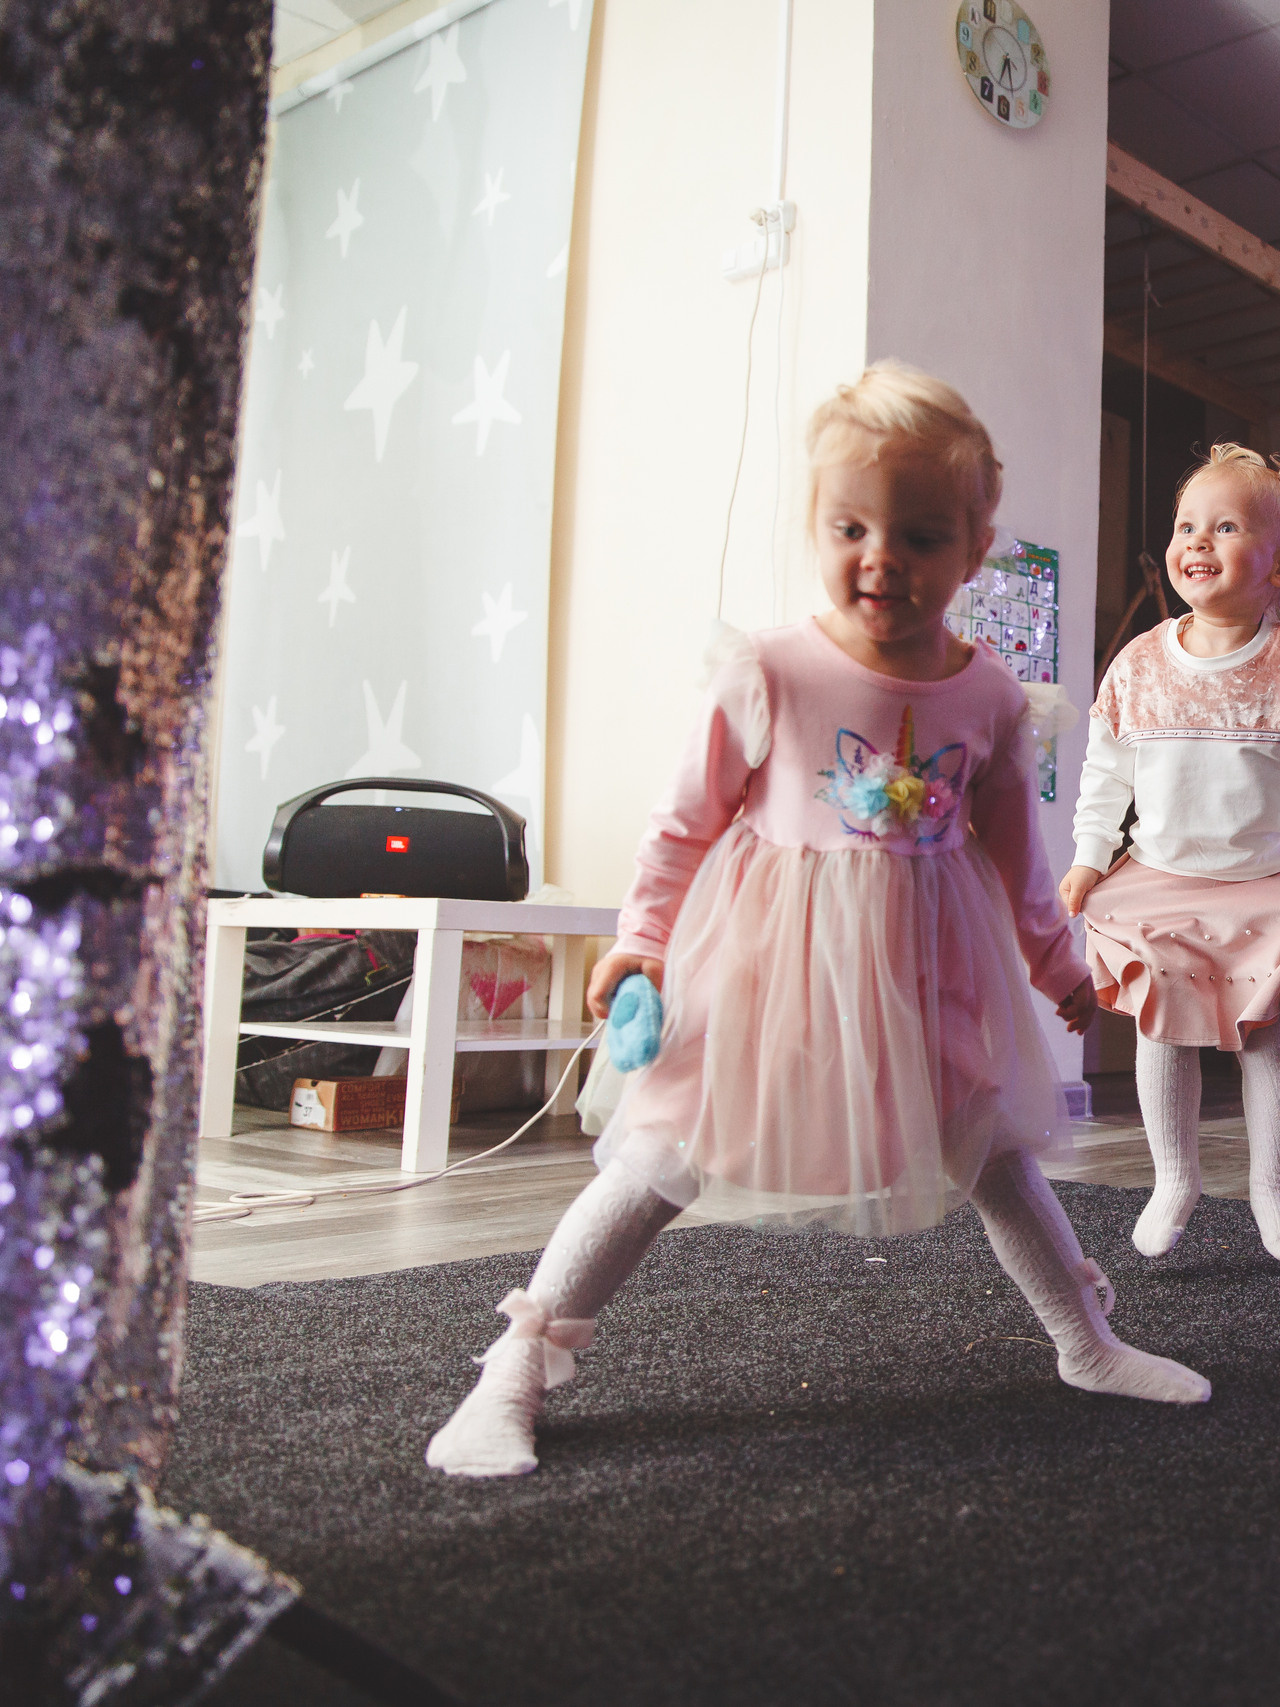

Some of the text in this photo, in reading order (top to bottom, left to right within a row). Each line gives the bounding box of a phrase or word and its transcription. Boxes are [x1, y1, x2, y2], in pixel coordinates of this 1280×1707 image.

[962, 27, 970, 42] 9
[969, 55, 977, 71] 8
[984, 81, 991, 96] 7
[1000, 101, 1008, 115] 6
[1030, 582, 1038, 597] Д
[975, 594, 985, 608] Ж
[1032, 607, 1039, 620] И
[975, 622, 983, 635] Л
[1033, 660, 1039, 672] Т
[341, 1113, 385, 1126] WOMAN
